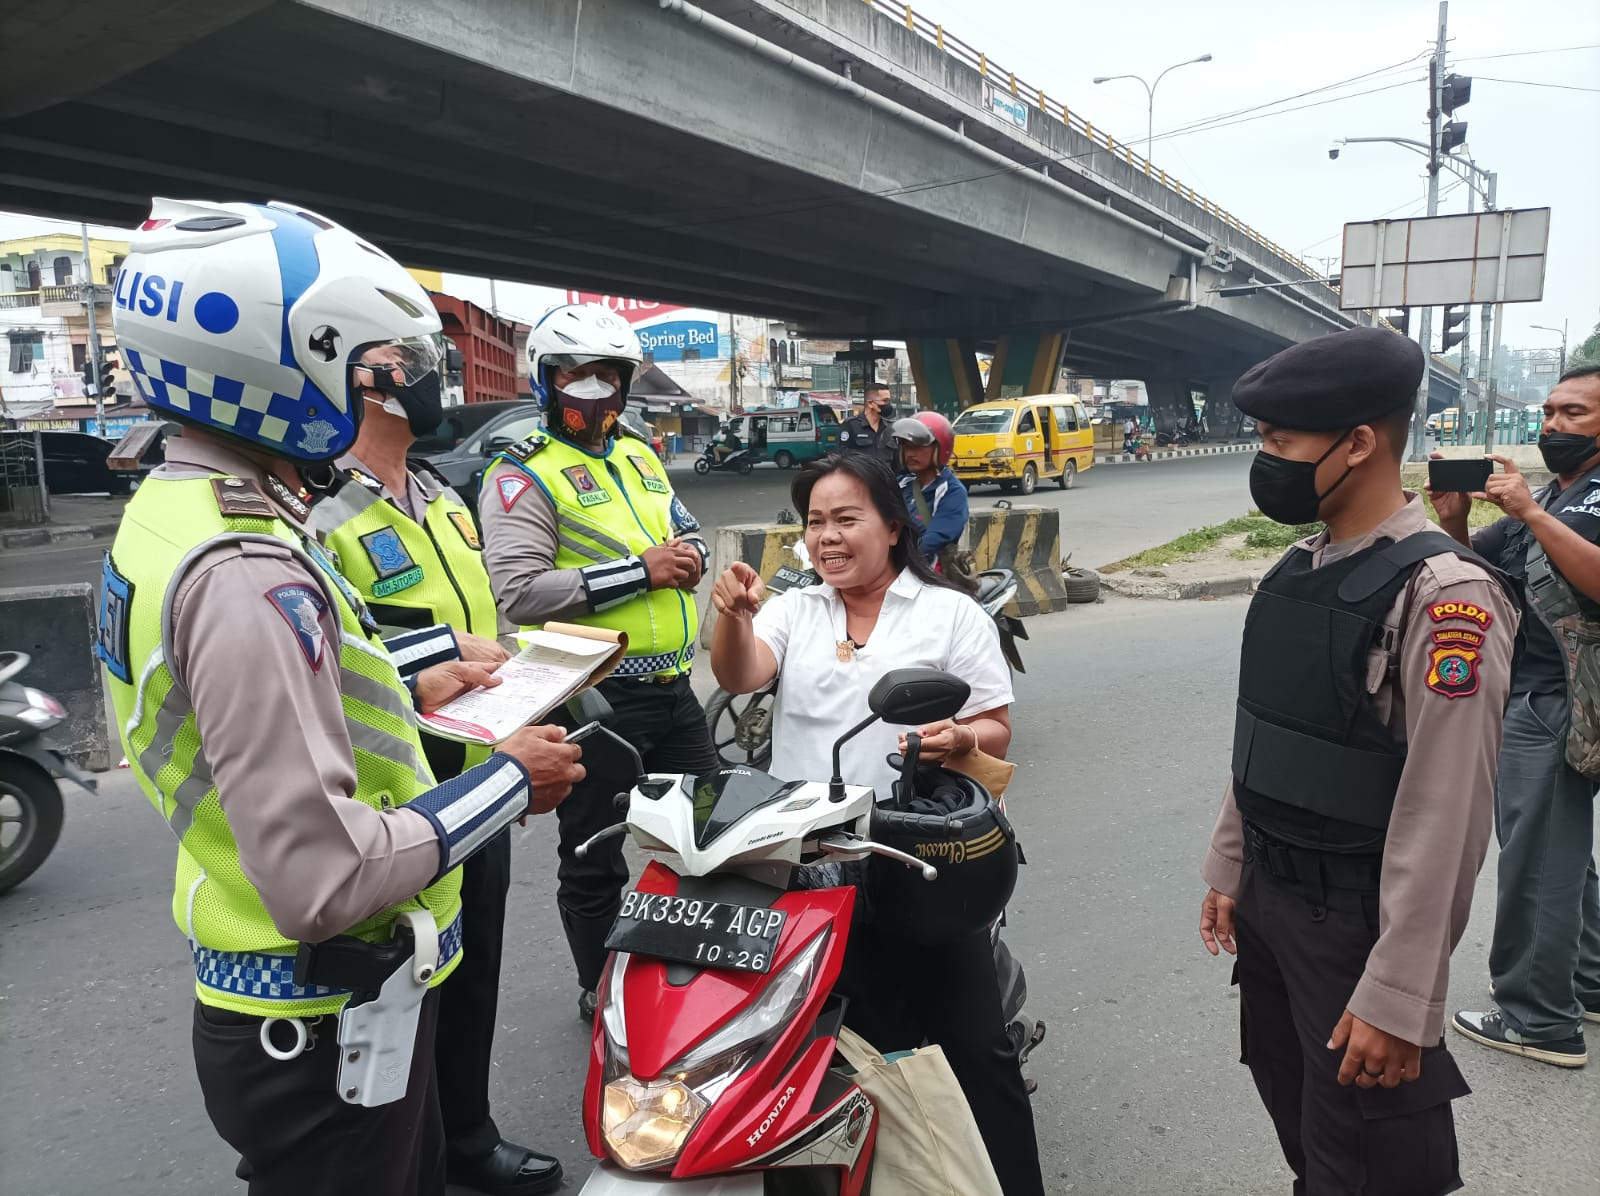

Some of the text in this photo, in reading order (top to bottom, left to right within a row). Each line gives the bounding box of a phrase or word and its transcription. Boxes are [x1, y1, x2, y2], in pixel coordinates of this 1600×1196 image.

[113, 269, 184, 322] LISI
[640, 327, 715, 349] Spring Bed
[1433, 603, 1487, 623] POLDA
[719, 768, 752, 777] HONDA
[914, 841, 966, 864] Classic
[726, 905, 782, 938] AGP
[746, 1086, 796, 1148] HONDA
